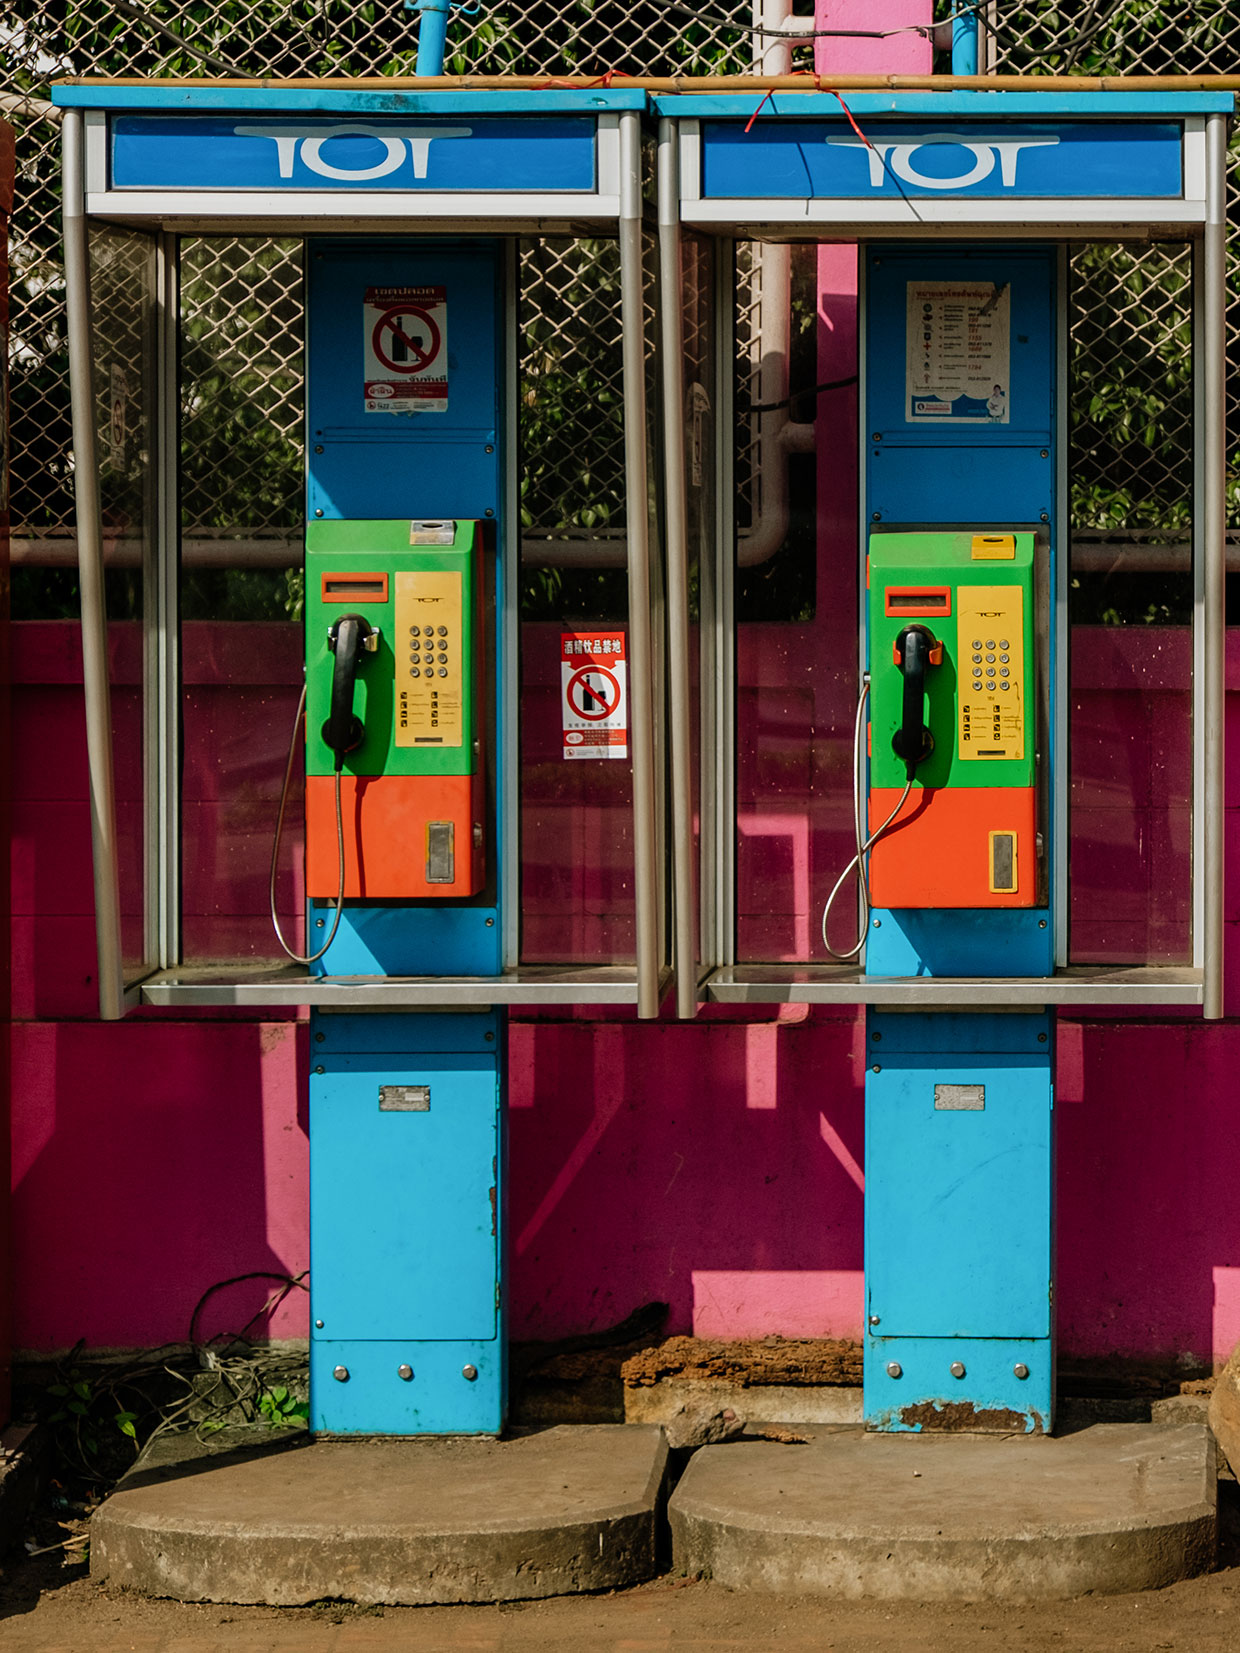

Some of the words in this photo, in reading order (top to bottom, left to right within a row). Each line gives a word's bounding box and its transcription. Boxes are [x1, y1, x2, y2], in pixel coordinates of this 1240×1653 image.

[233, 125, 473, 180] TOT
[826, 133, 1059, 189] TOT
[564, 638, 622, 655] 酒精饮品禁地
